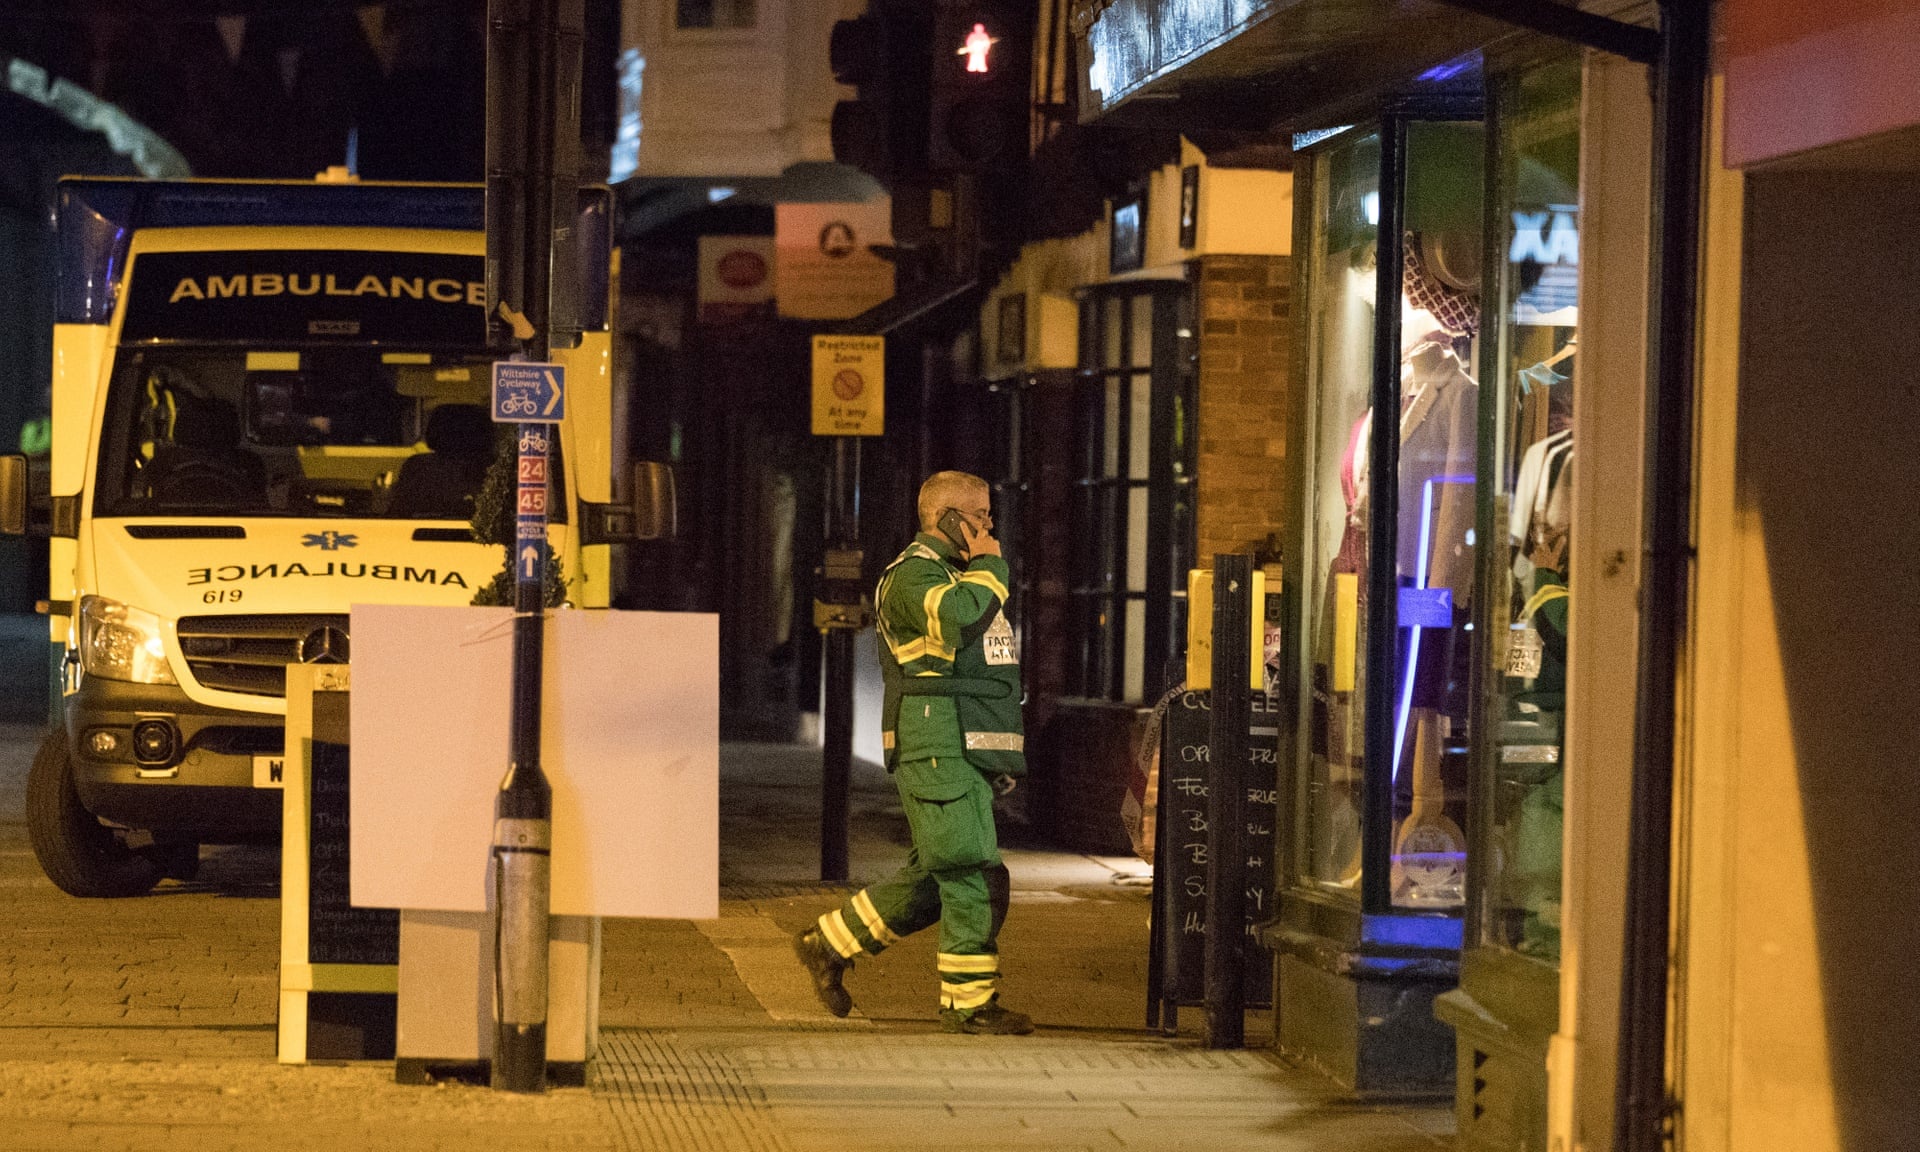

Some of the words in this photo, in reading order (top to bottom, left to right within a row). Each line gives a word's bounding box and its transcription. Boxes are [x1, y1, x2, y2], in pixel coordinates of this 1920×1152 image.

[169, 274, 486, 307] AMBULANCE
[818, 340, 881, 350] Restricted
[833, 353, 862, 363] Zone
[501, 369, 540, 379] Wiltshire
[498, 378, 541, 391] Cycleway
[828, 407, 842, 417] At
[847, 409, 867, 419] any
[834, 420, 861, 429] time
[521, 461, 544, 478] 24
[520, 493, 544, 510] 45
[203, 589, 243, 604] 619
[270, 760, 283, 782] W
